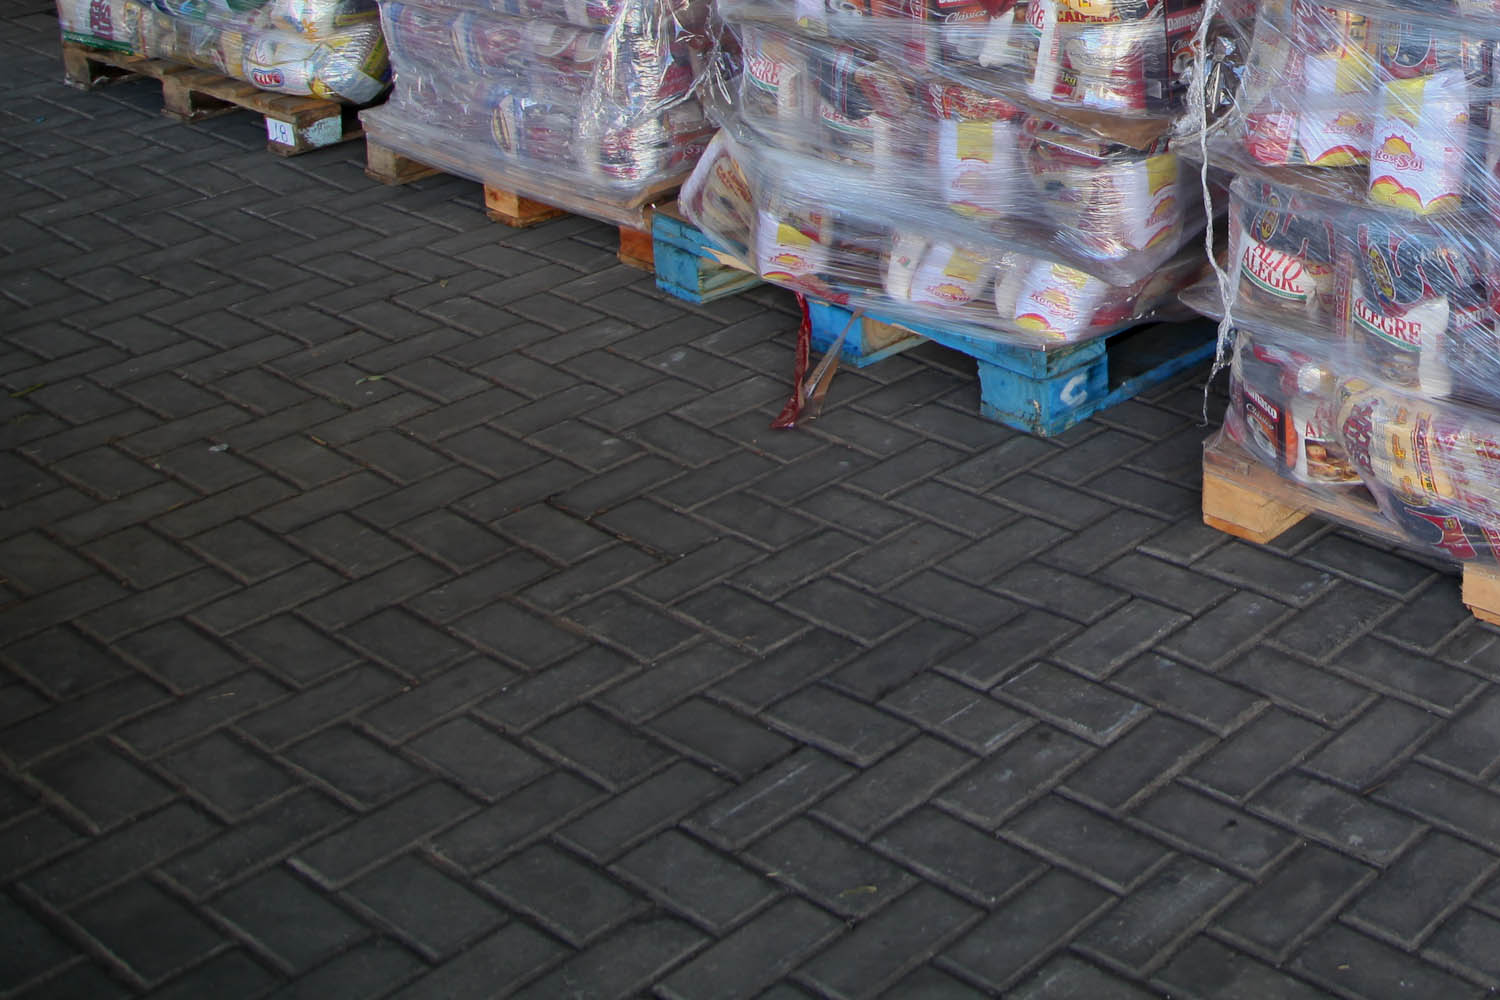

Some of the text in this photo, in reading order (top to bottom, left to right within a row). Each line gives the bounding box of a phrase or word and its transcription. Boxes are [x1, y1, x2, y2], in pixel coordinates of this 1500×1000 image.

[1167, 13, 1201, 32] Damas
[1253, 240, 1301, 285] ALTO
[1353, 297, 1423, 346] ALEGRE
